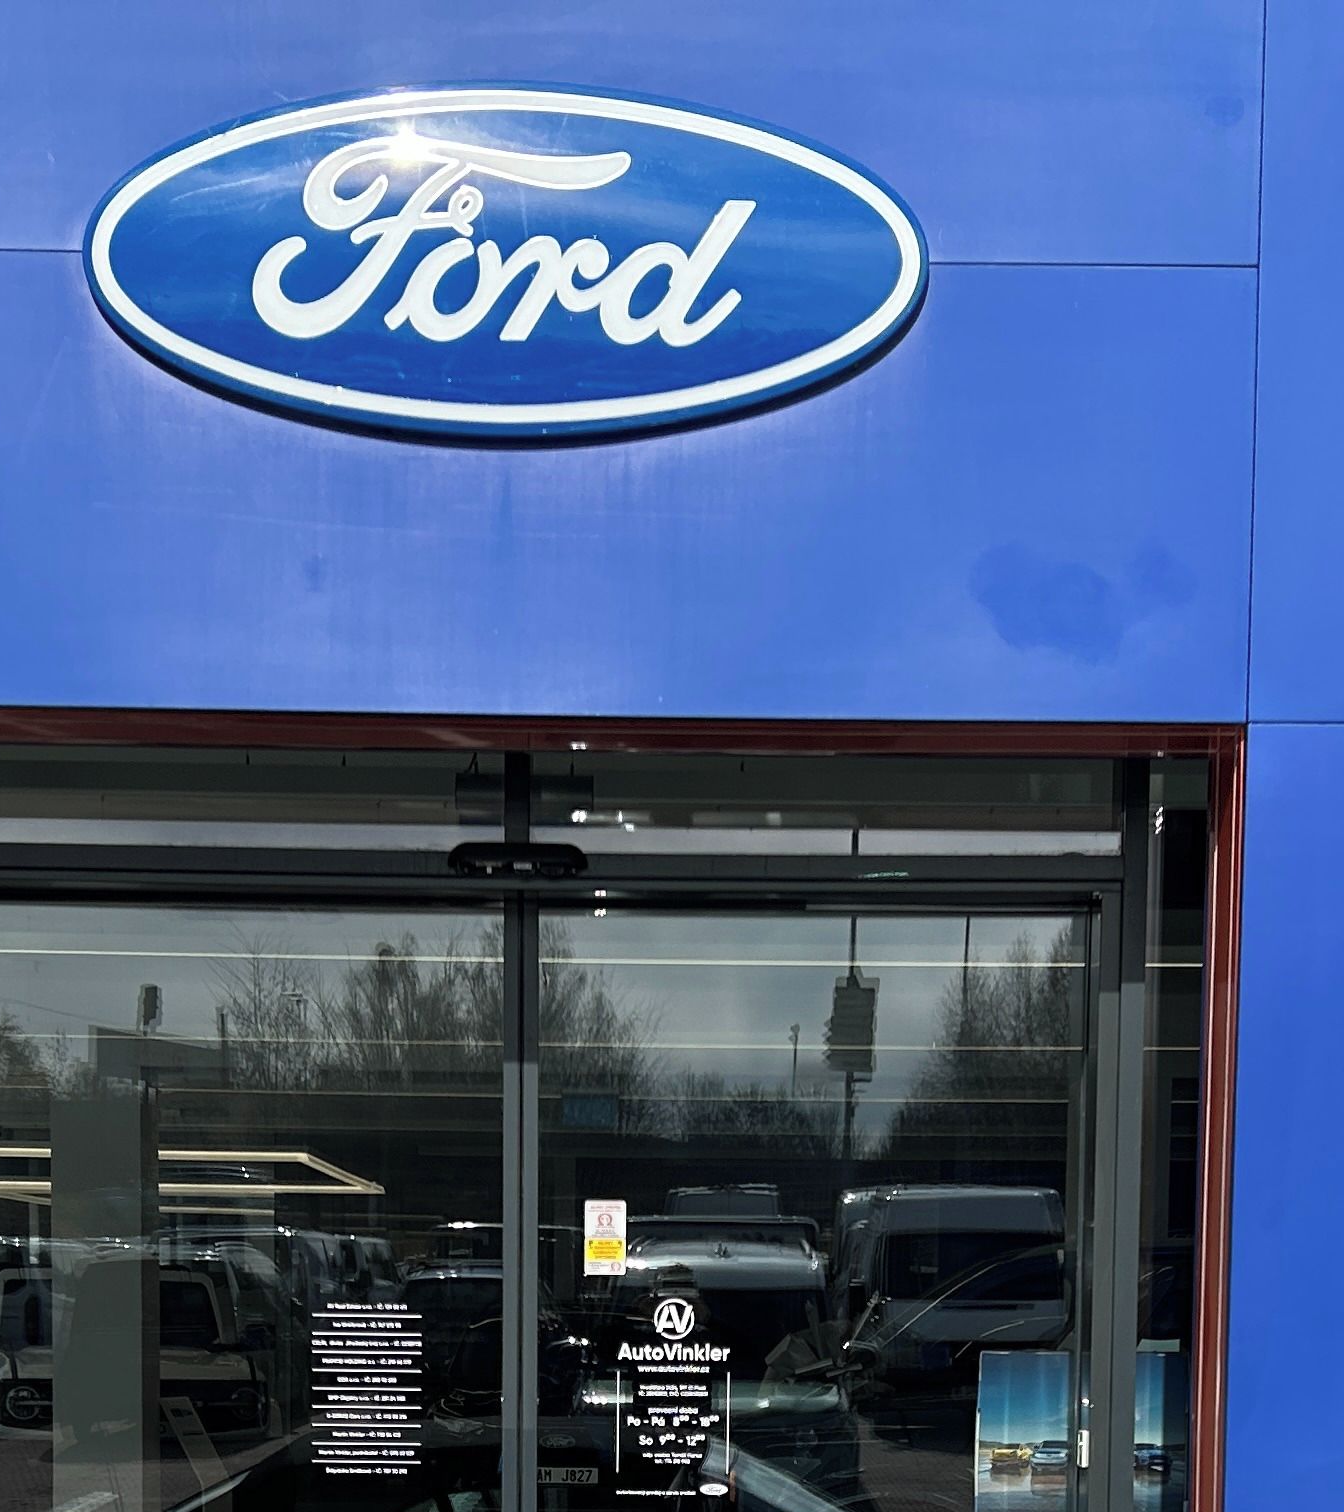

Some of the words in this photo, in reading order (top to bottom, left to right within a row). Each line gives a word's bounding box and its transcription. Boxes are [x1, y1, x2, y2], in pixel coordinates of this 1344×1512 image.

[252, 134, 757, 348] Ford
[617, 1342, 731, 1361] AutoVinkler
[627, 1415, 641, 1427] Po
[651, 1415, 666, 1427] Pá
[638, 1434, 654, 1446] So
[537, 1468, 553, 1482] AM
[560, 1469, 593, 1483] J827
